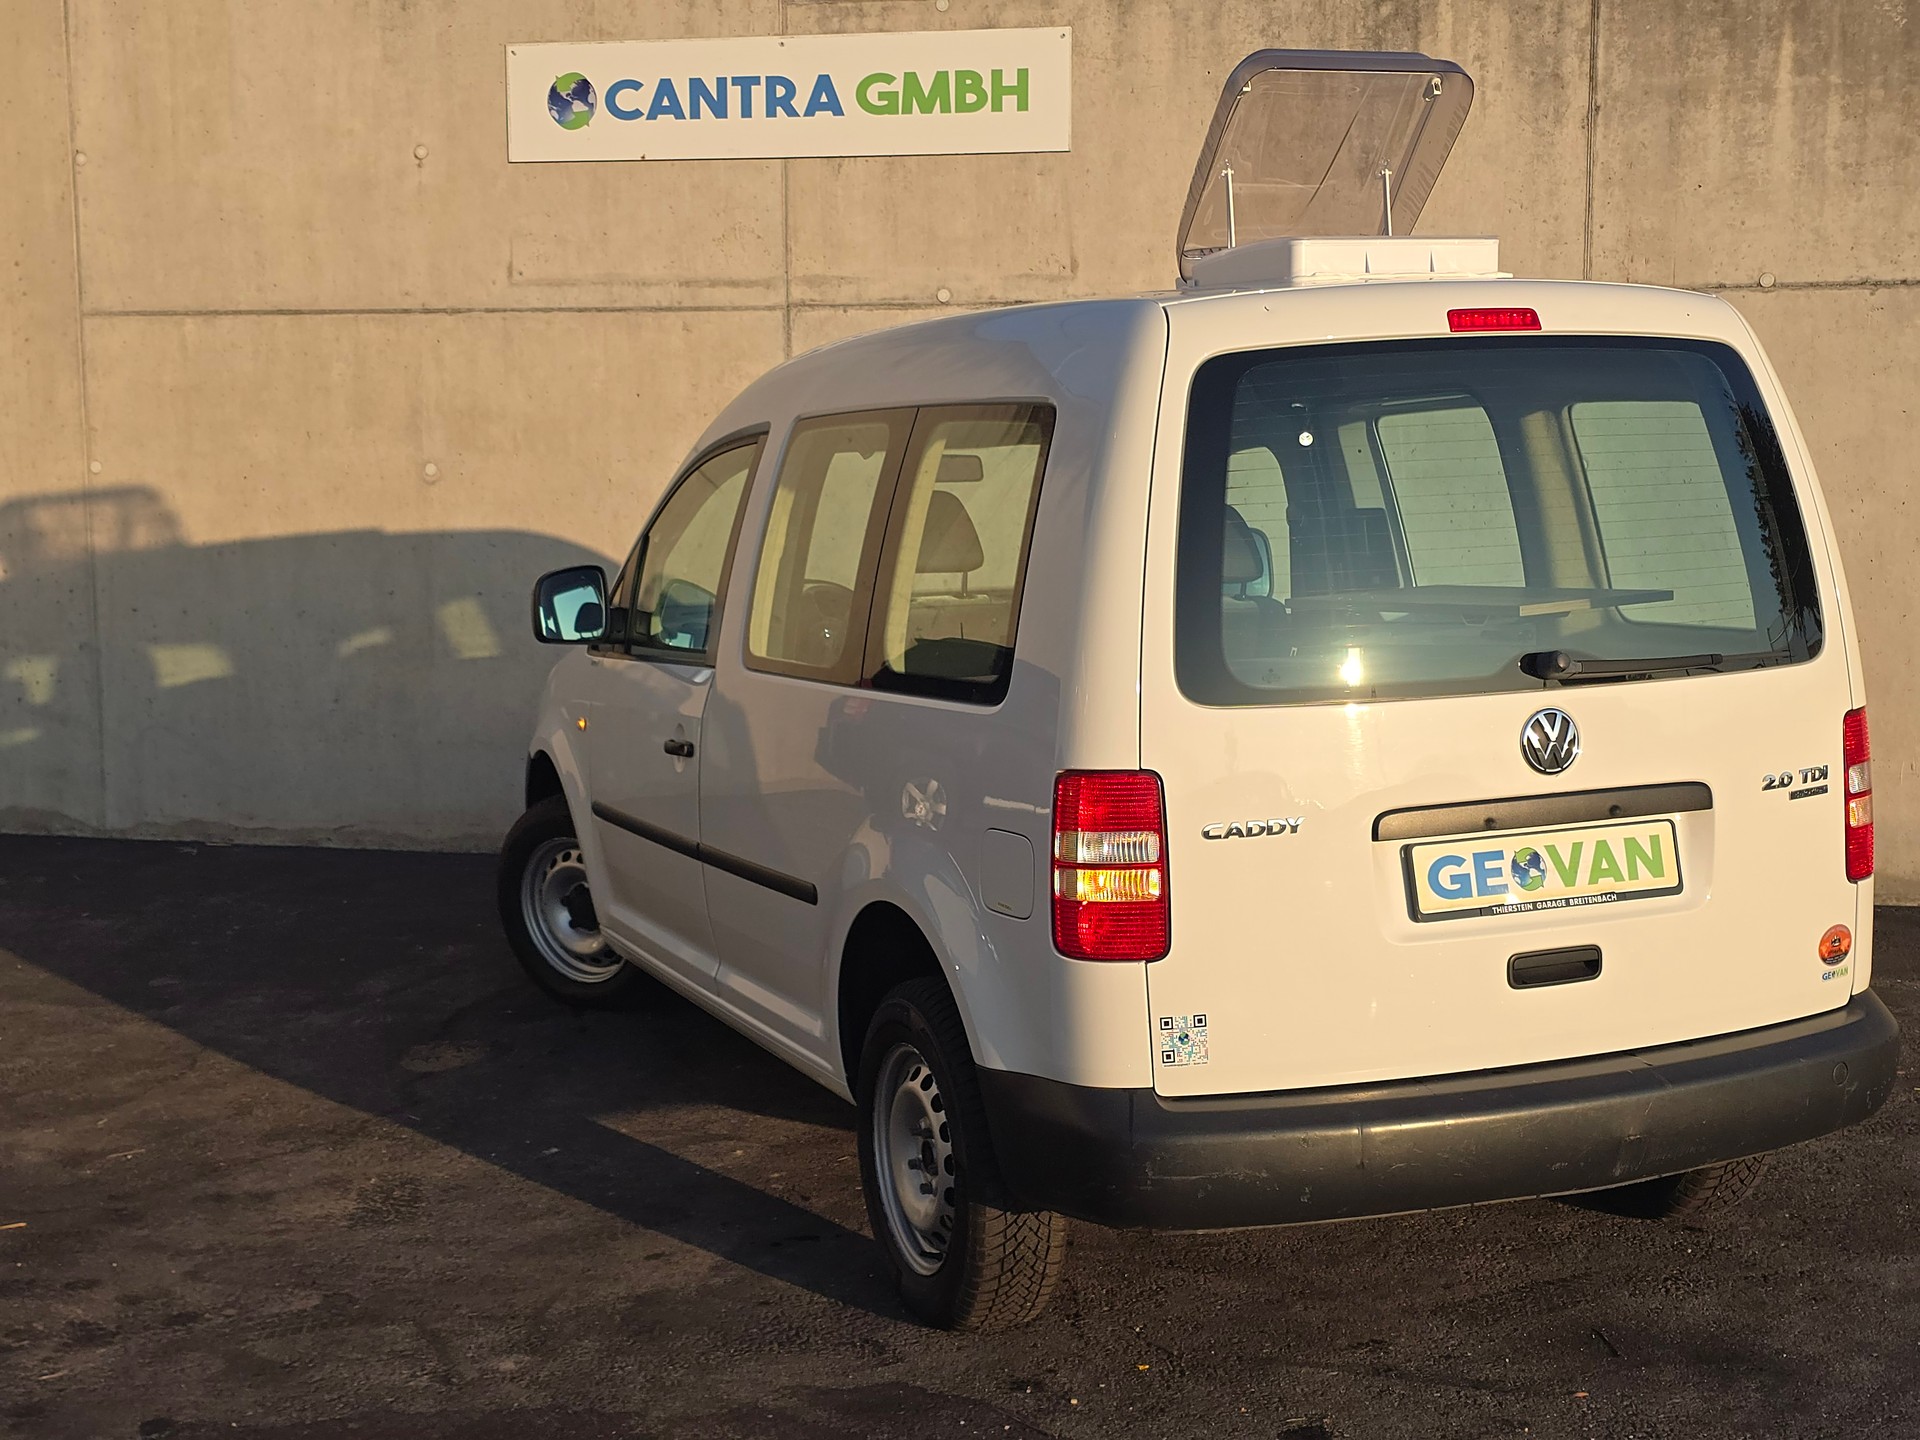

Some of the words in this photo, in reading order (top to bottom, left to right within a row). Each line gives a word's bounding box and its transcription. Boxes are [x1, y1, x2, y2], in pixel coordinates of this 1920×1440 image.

[604, 74, 845, 121] CANTRA
[855, 67, 1030, 116] GMBH
[1798, 764, 1829, 784] TDI
[1200, 816, 1307, 840] CADDY
[1491, 902, 1534, 915] THIERSTEIN
[1536, 899, 1567, 910] GARAGE
[1569, 893, 1618, 906] BREITENBACH
